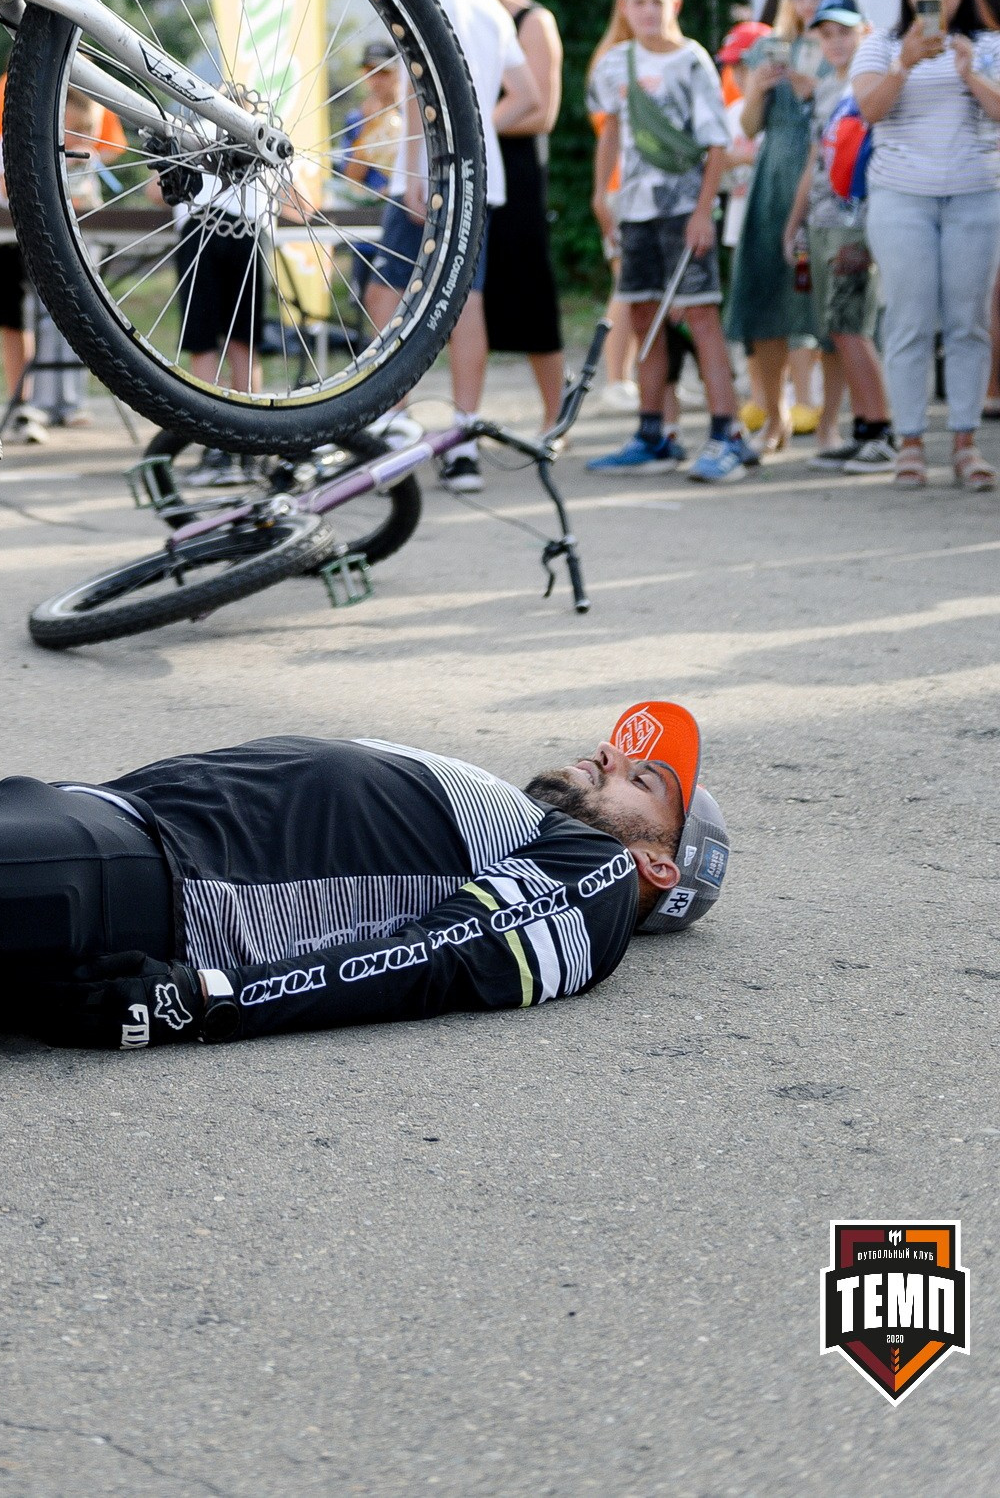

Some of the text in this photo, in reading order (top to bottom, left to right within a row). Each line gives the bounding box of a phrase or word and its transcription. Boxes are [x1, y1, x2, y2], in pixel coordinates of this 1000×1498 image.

[458, 180, 474, 254] MICHELIN
[490, 885, 570, 933] YOKO
[339, 941, 429, 982] YOKO
[239, 965, 327, 1006] YOKO
